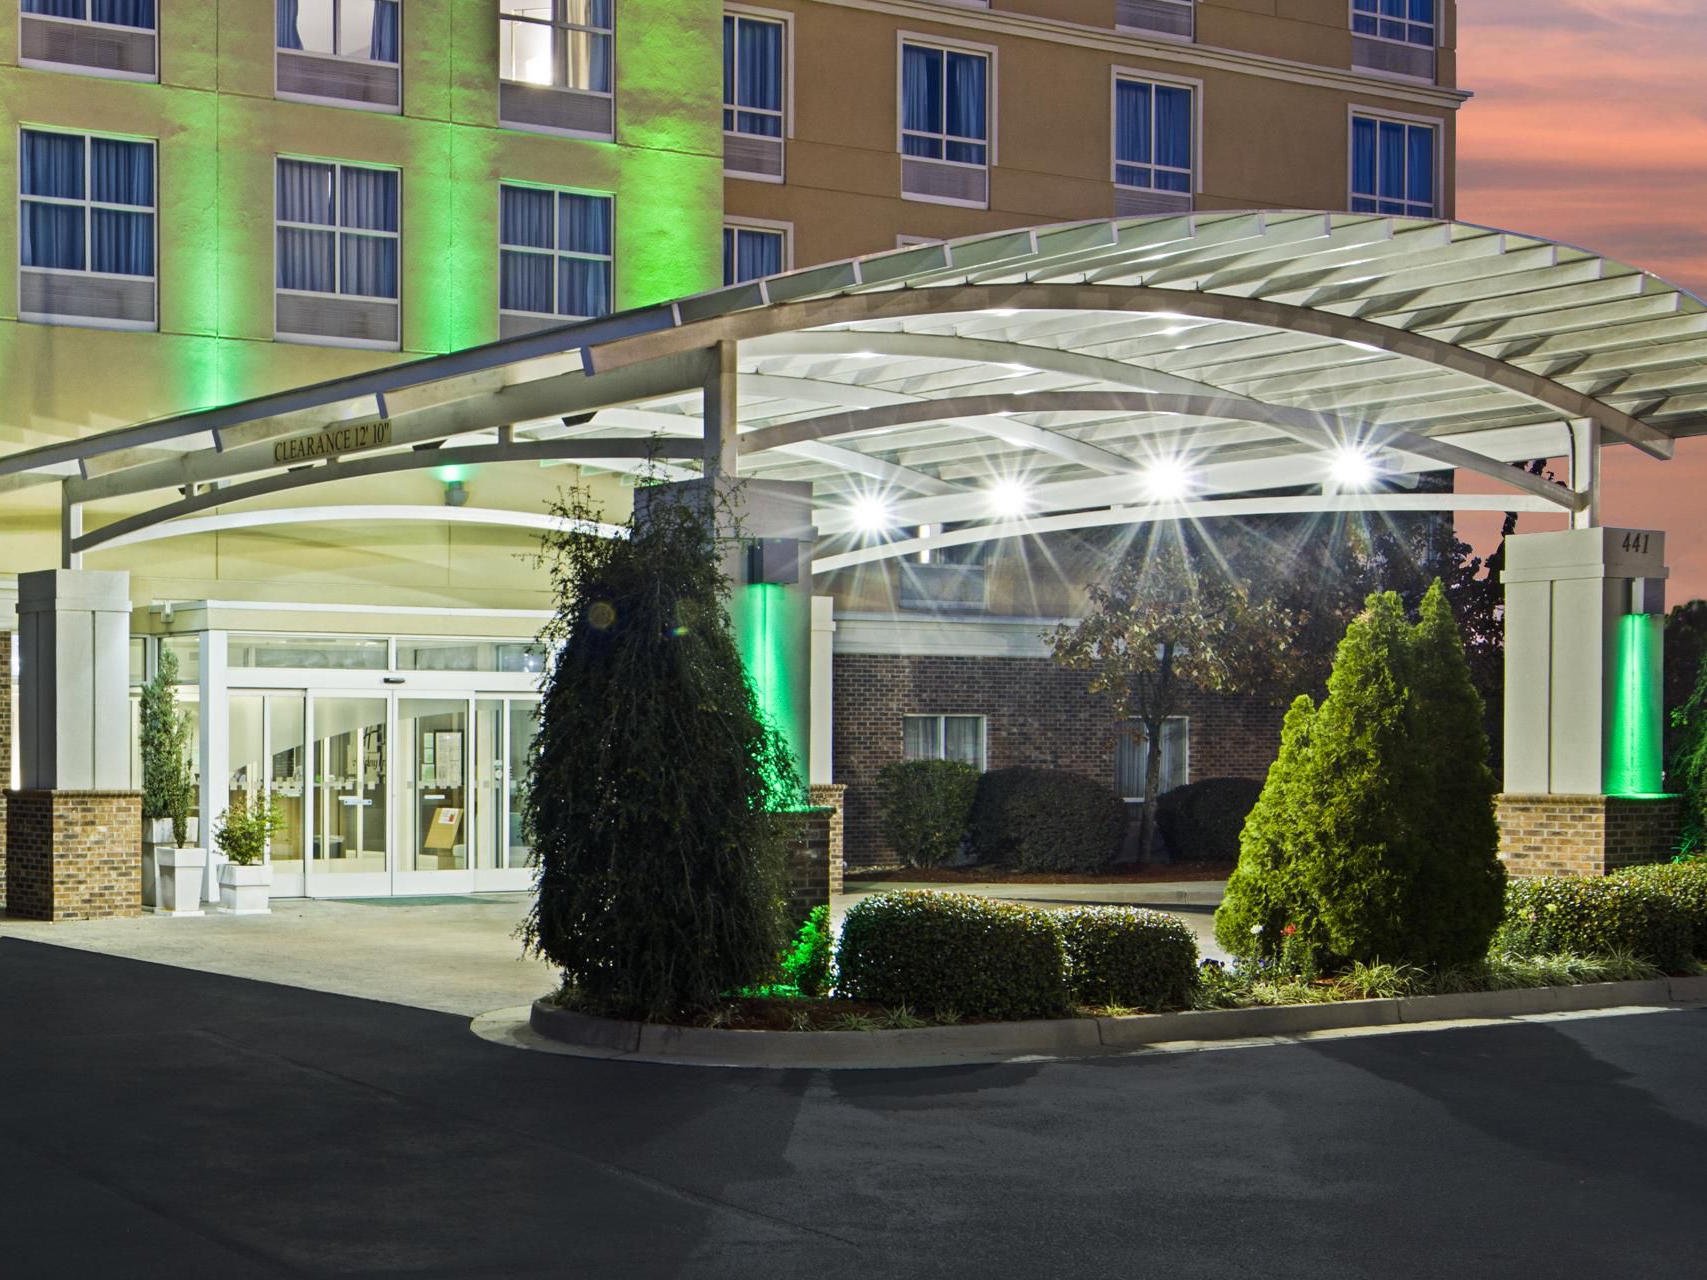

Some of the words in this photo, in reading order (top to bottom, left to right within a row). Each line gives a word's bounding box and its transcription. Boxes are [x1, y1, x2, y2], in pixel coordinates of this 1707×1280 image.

[274, 429, 351, 462] CLEARANCE
[355, 425, 369, 448] 12'
[373, 422, 390, 440] 10"
[1622, 532, 1649, 554] 441
